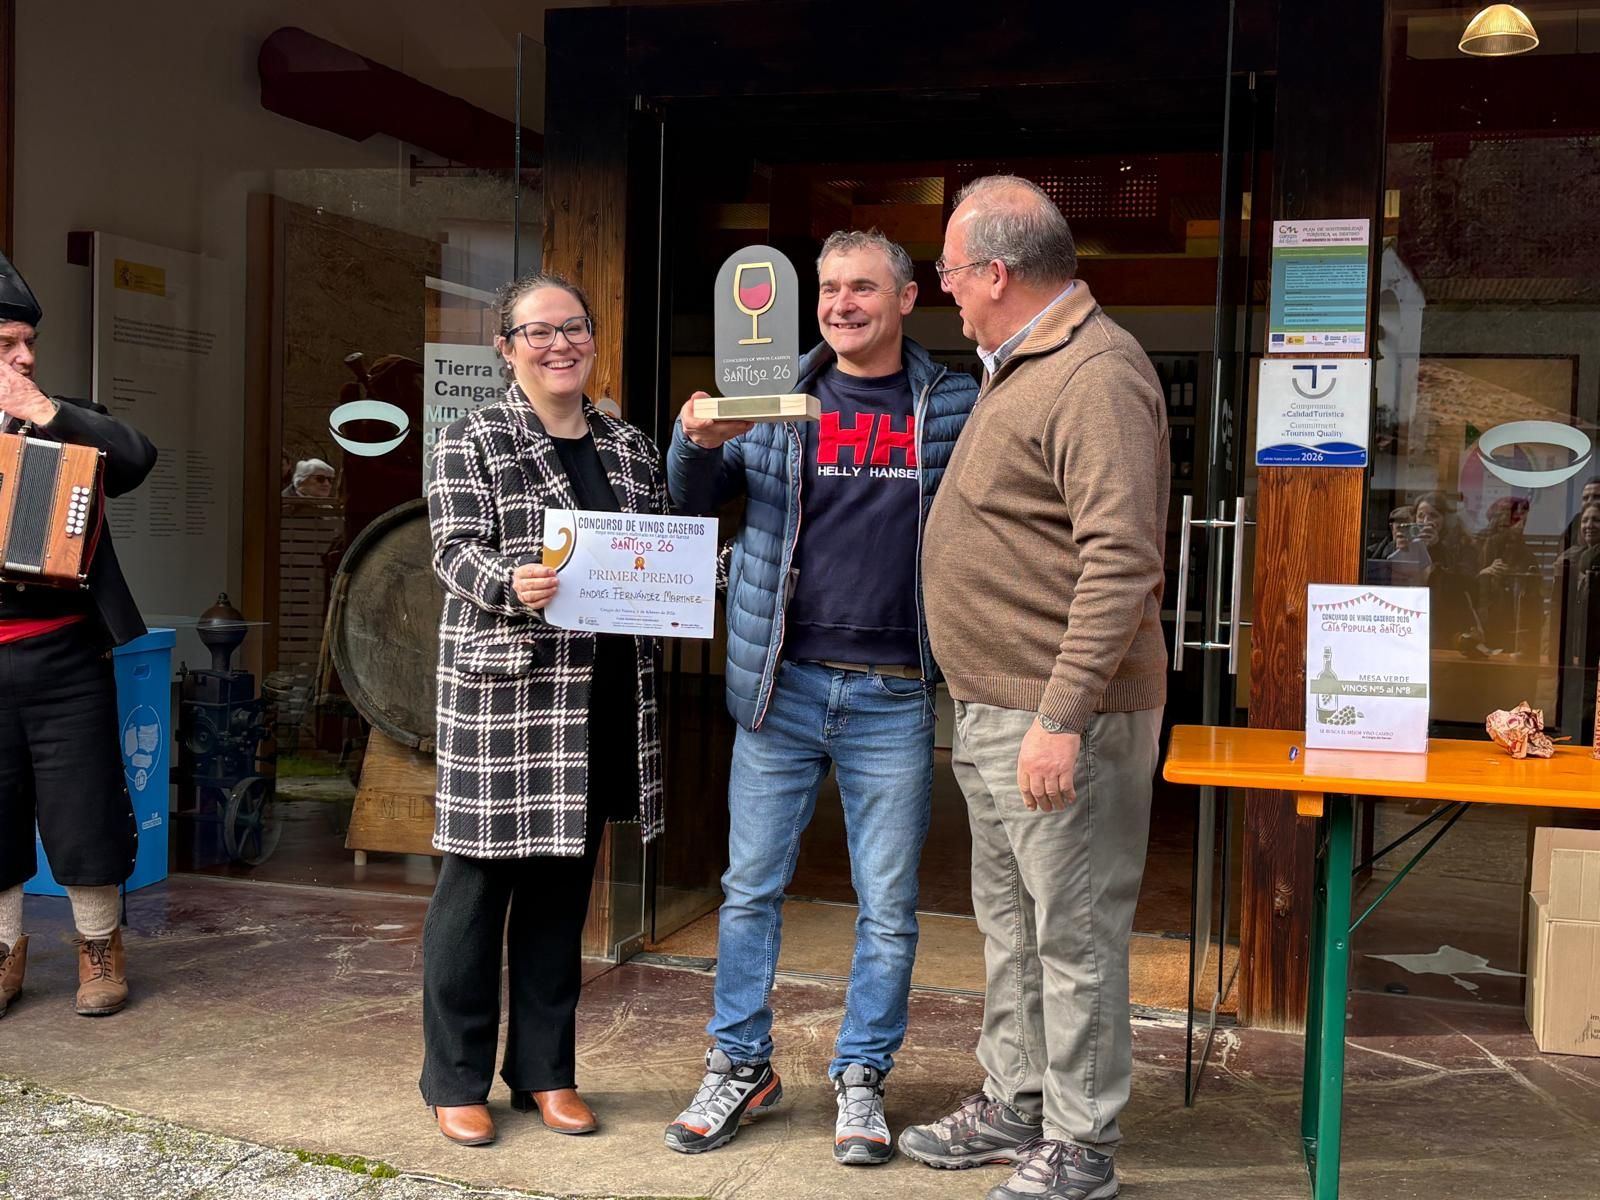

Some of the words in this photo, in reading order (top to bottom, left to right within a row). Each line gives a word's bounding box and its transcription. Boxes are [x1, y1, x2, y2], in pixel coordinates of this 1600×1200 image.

[434, 359, 493, 377] Tierra
[773, 364, 791, 380] 26
[1285, 429, 1315, 437] Tourism
[1316, 429, 1344, 438] Quality
[1301, 452, 1324, 462] 2026
[817, 466, 861, 477] HELLY
[577, 516, 623, 531] CONCURSO
[625, 519, 636, 532] DE
[639, 520, 664, 534] VINOS
[667, 521, 705, 536] CASEROS
[657, 539, 674, 553] 26
[588, 568, 638, 583] PRIMER
[642, 571, 694, 585] PREMIO
[1322, 613, 1348, 621] CONCURSO
[1349, 613, 1356, 622] DE
[1357, 614, 1372, 622] VINOS
[1373, 614, 1395, 623] CASEROS
[1359, 674, 1382, 682] MESA
[1383, 675, 1410, 683] VERDE
[1341, 684, 1368, 693] VINOS
[1386, 686, 1394, 694] al
